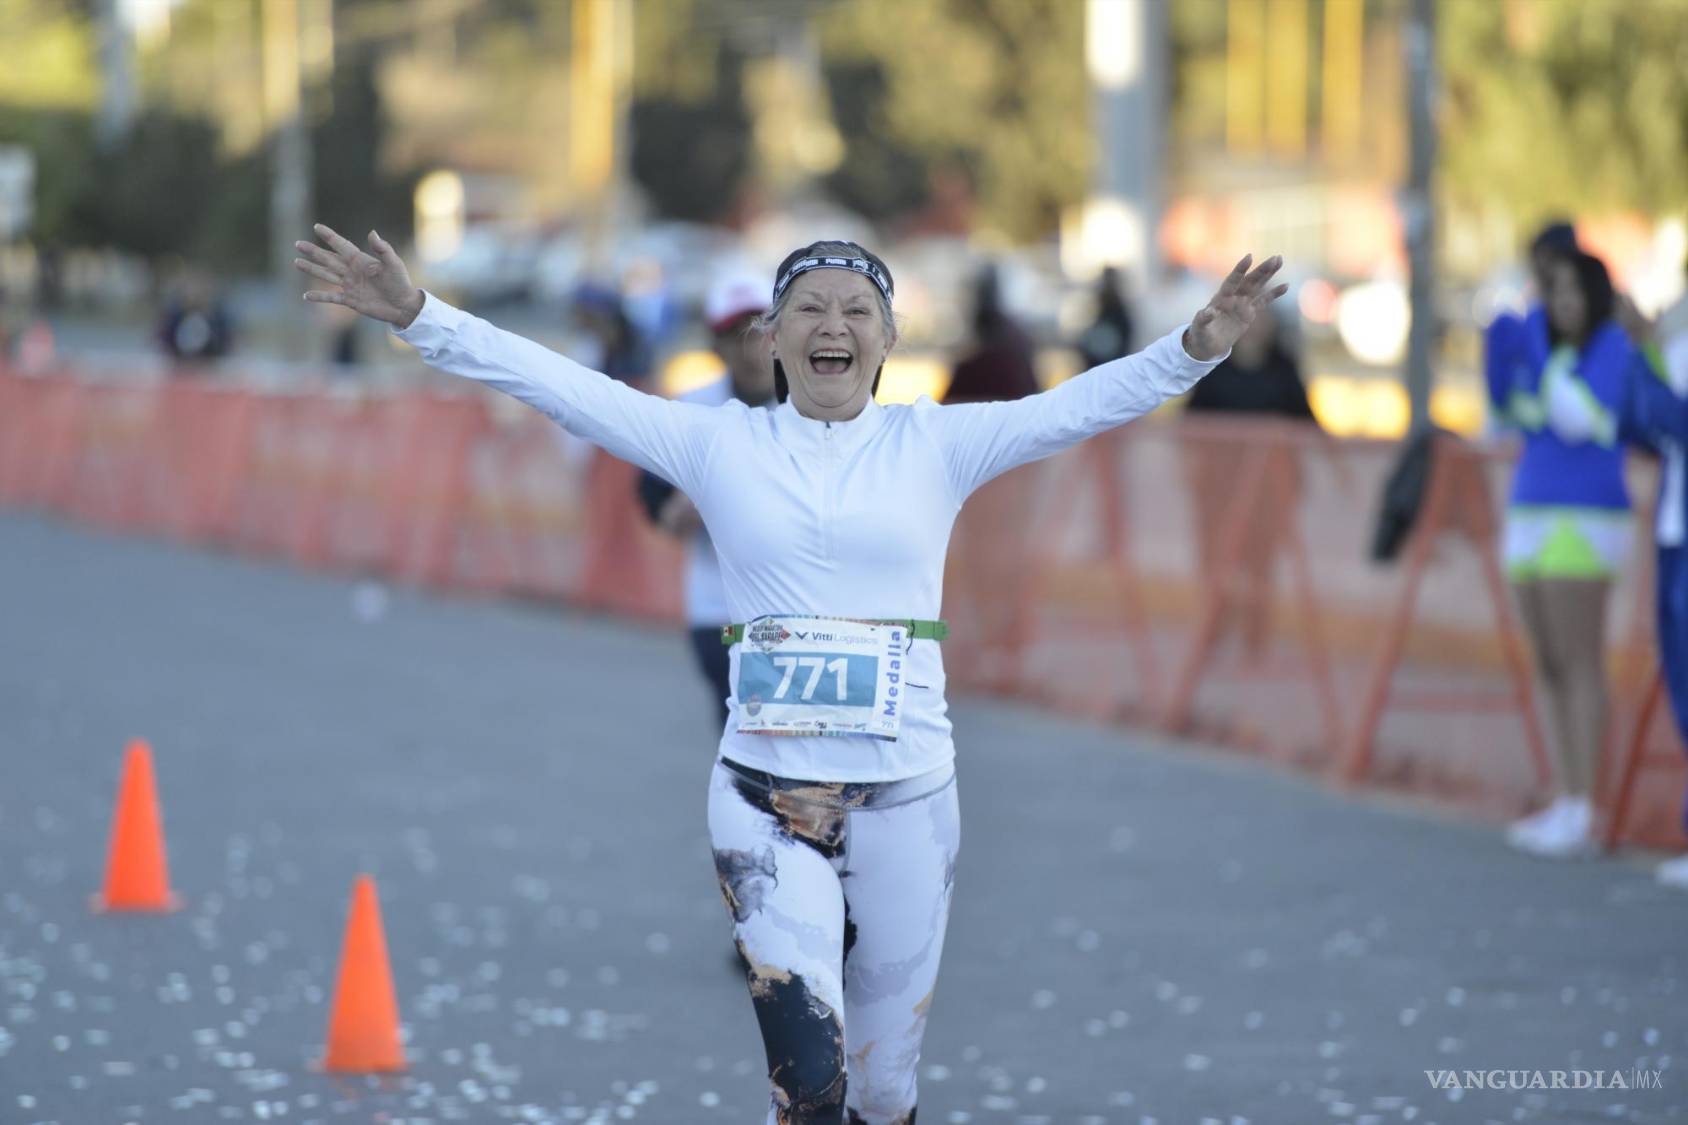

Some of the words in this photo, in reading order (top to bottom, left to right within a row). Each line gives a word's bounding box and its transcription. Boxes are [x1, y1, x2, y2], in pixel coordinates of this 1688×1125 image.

[812, 632, 833, 641] Vitti
[834, 633, 878, 645] Logistics
[773, 656, 848, 701] 771
[883, 631, 901, 716] Medalla
